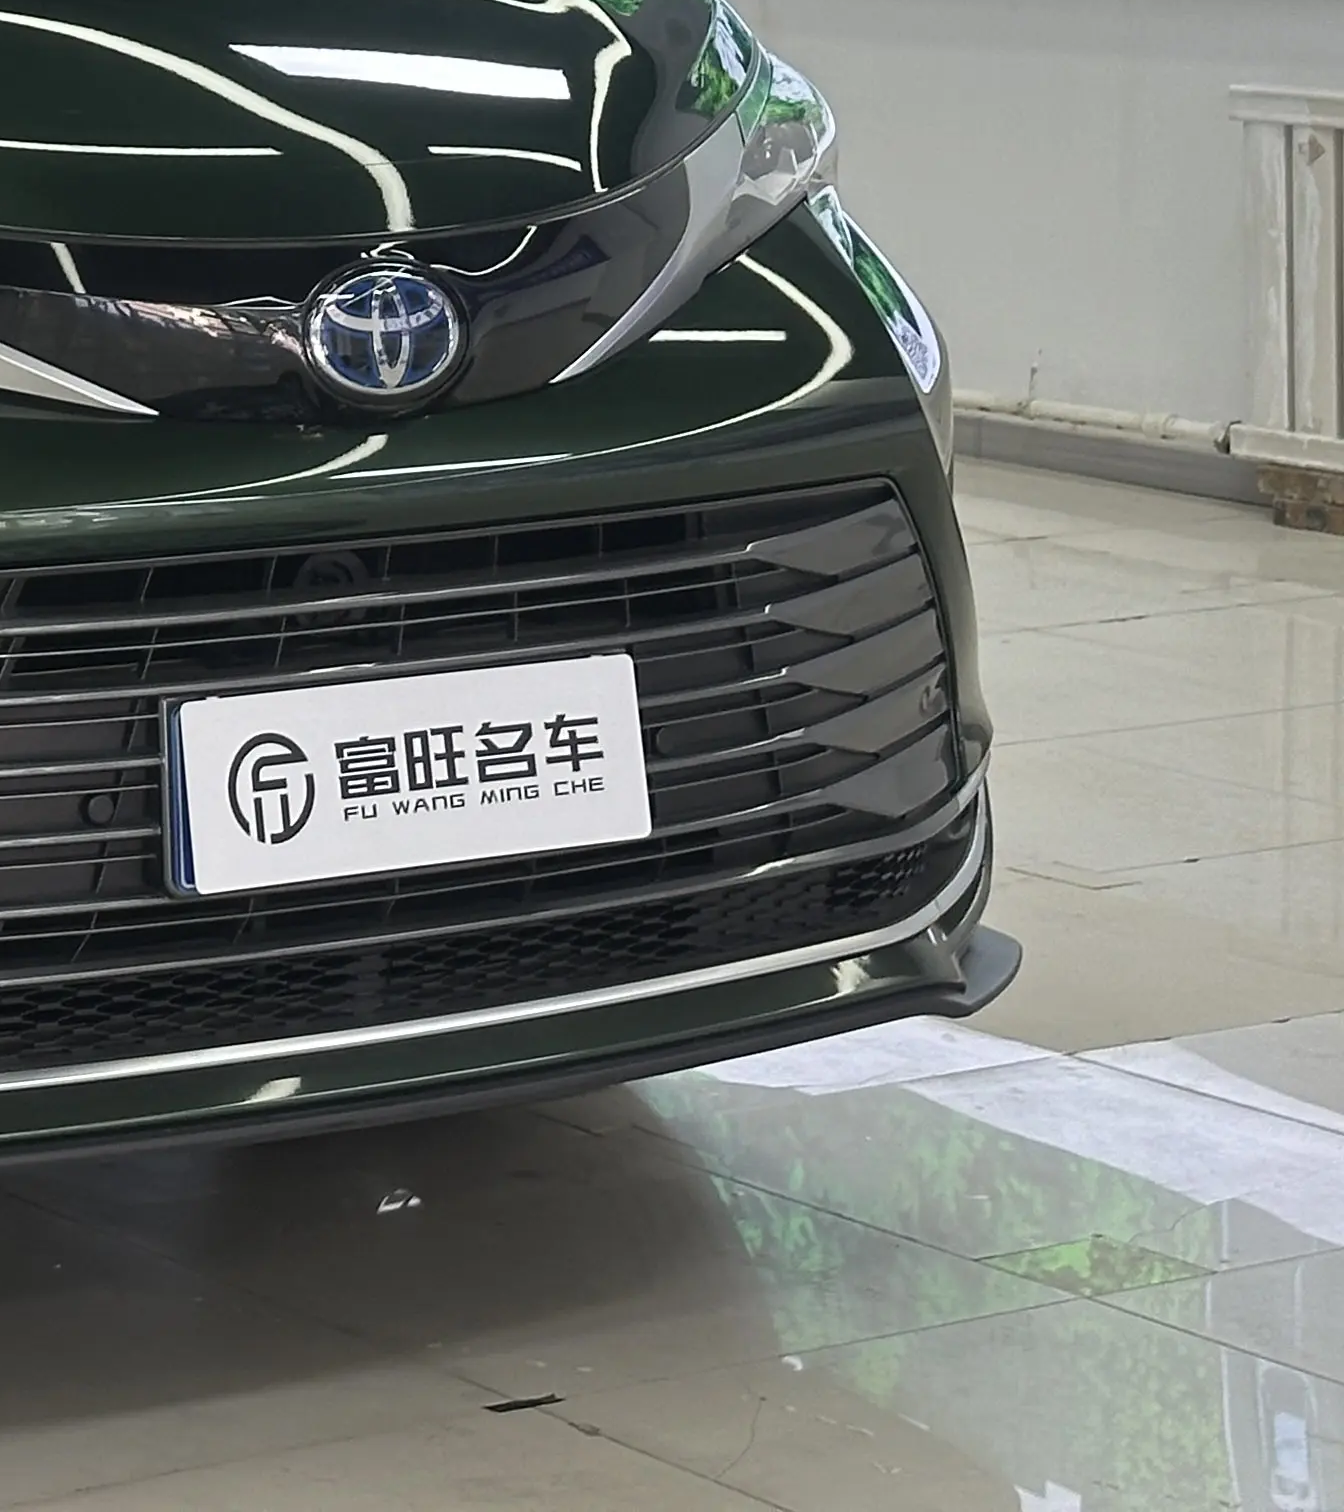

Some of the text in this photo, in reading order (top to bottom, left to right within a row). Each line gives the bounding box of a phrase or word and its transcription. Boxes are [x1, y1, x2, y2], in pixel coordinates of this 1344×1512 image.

[334, 714, 605, 800] 富旺名车
[343, 776, 606, 822] FU WANG MING CHE
